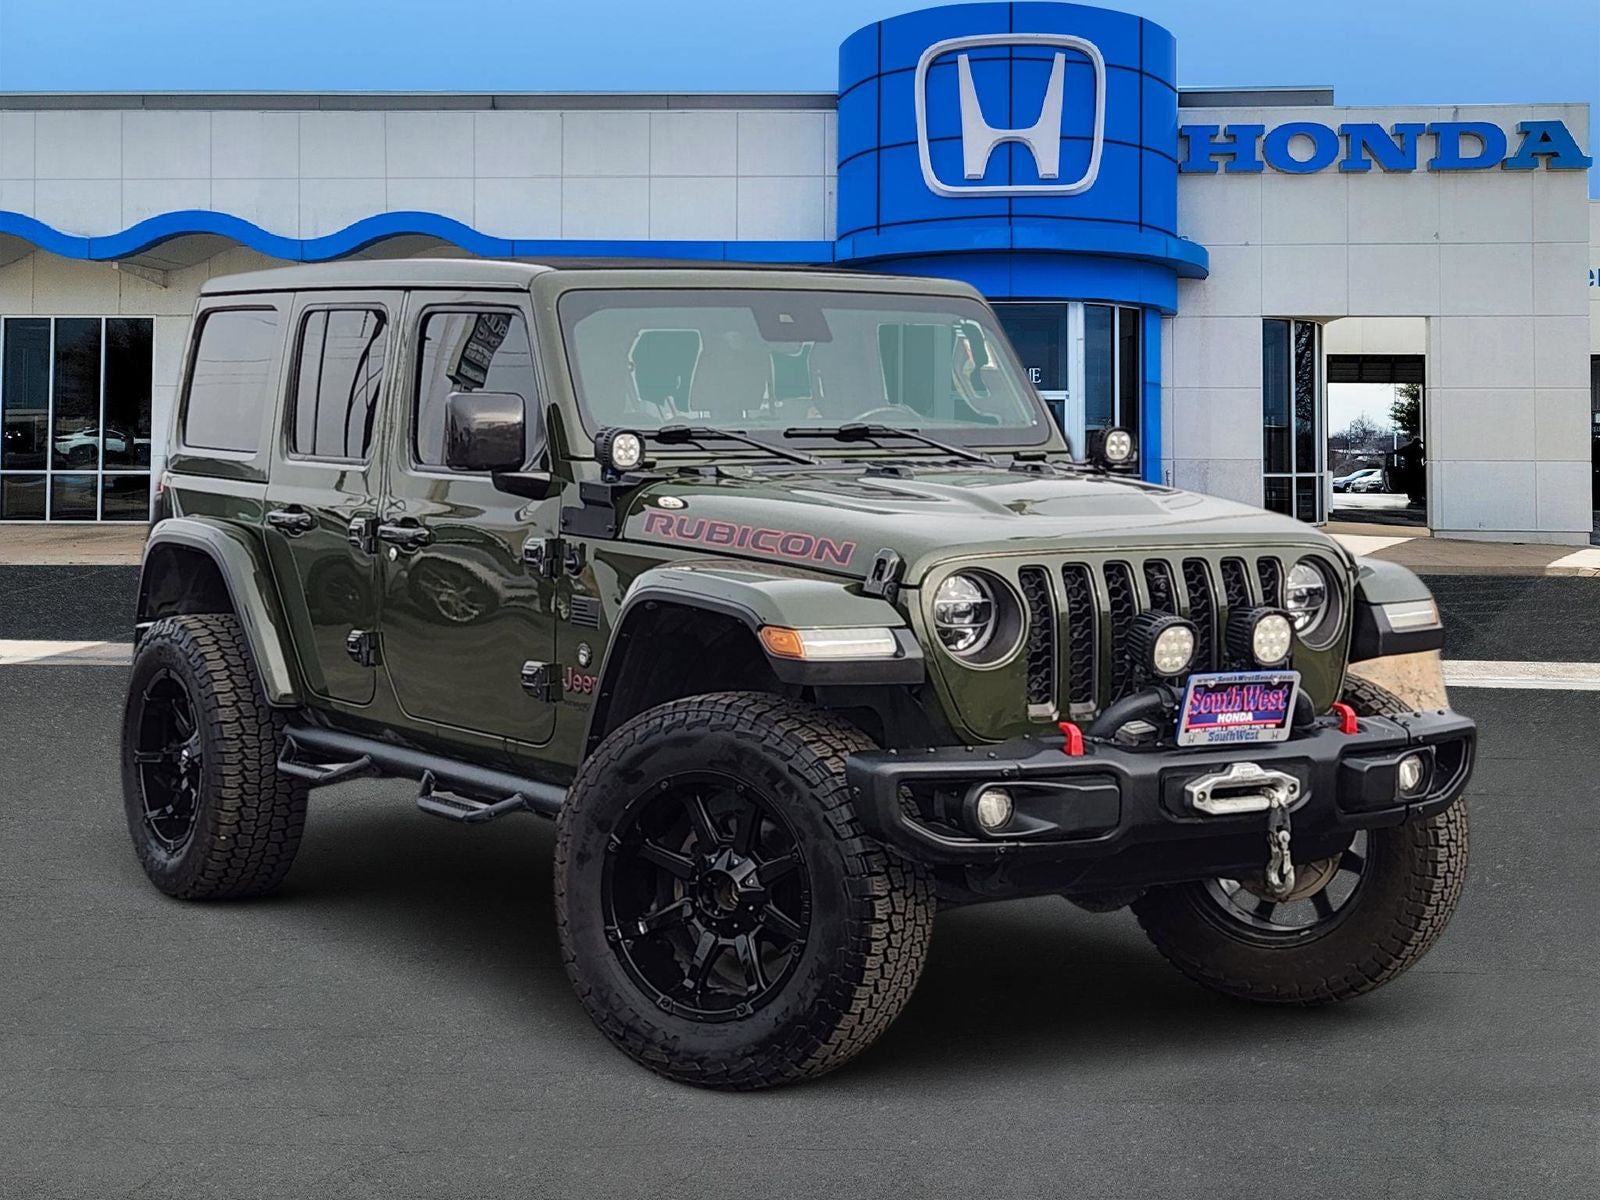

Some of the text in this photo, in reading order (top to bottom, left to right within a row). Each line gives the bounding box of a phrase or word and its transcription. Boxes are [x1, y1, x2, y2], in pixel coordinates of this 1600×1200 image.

[1179, 120, 1593, 174] HONDA
[644, 511, 857, 567] RUBICON
[1216, 711, 1254, 723] HONDA
